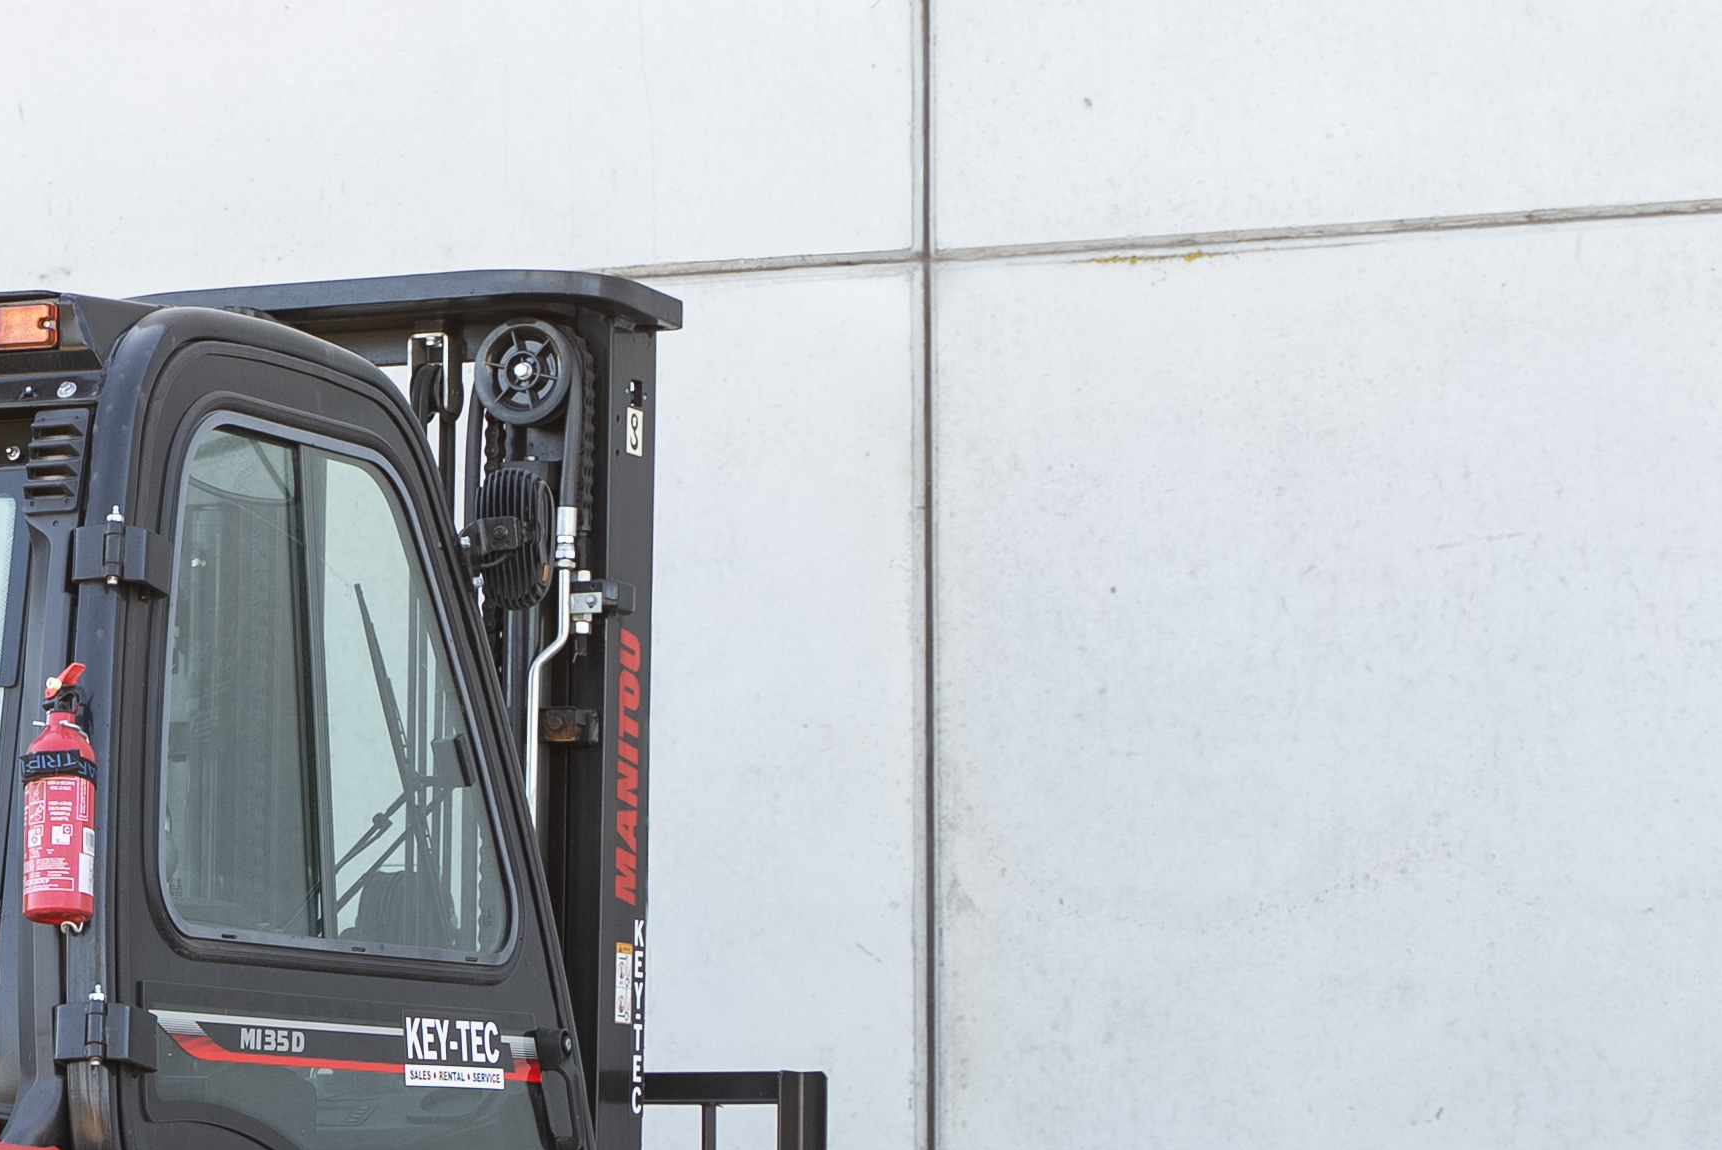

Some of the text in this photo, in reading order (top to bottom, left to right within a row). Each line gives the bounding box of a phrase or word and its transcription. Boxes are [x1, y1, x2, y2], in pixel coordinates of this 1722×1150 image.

[615, 628, 641, 906] MANITOU
[405, 1016, 500, 1064] KEY-TEC
[409, 1069, 501, 1084] SALES RENTAL SERVICE
